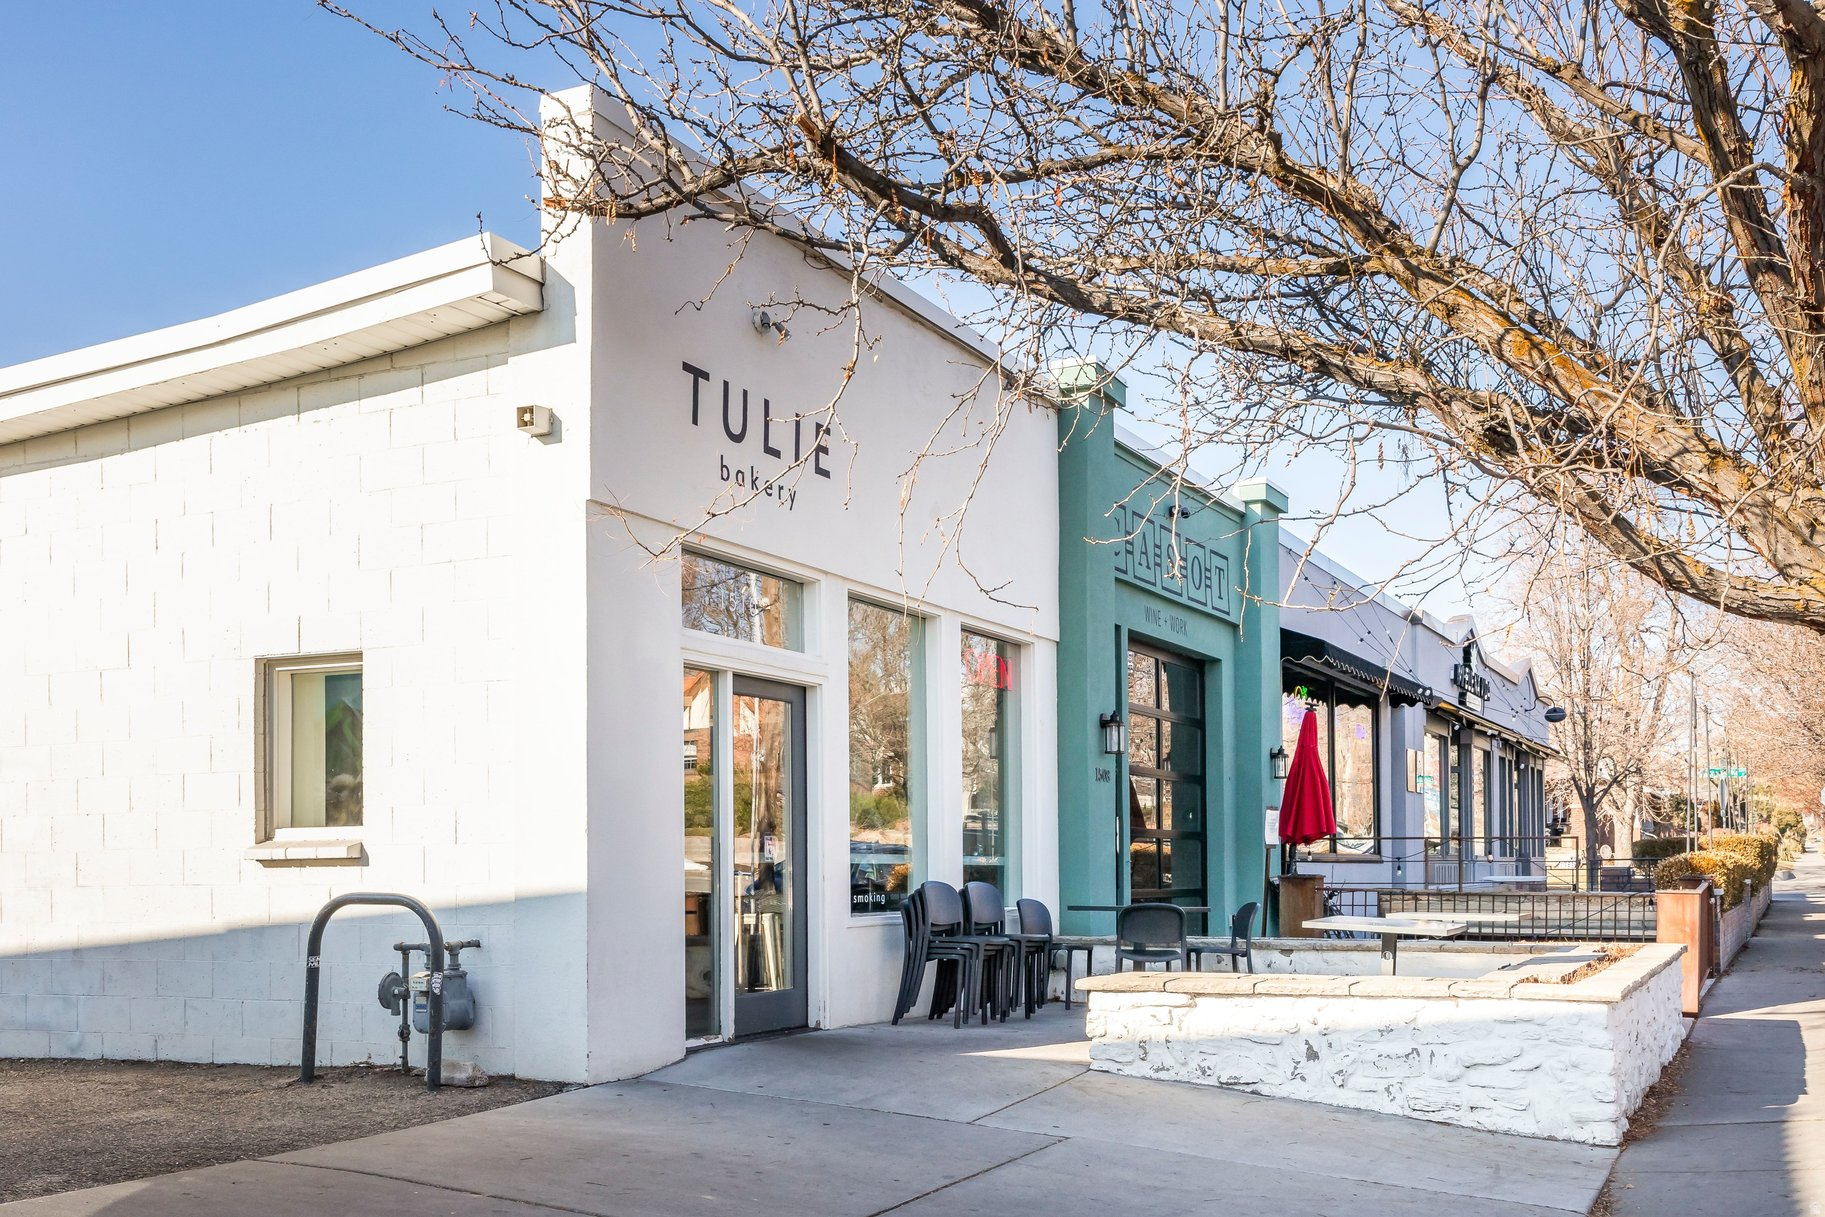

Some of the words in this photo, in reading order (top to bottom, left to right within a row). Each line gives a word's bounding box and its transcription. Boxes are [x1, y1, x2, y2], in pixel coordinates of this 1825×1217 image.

[682, 361, 831, 479] TULIE
[720, 454, 797, 511] bakery
[1144, 605, 1161, 628] WINE
[1170, 614, 1188, 637] WORK
[853, 892, 886, 905] smoking
